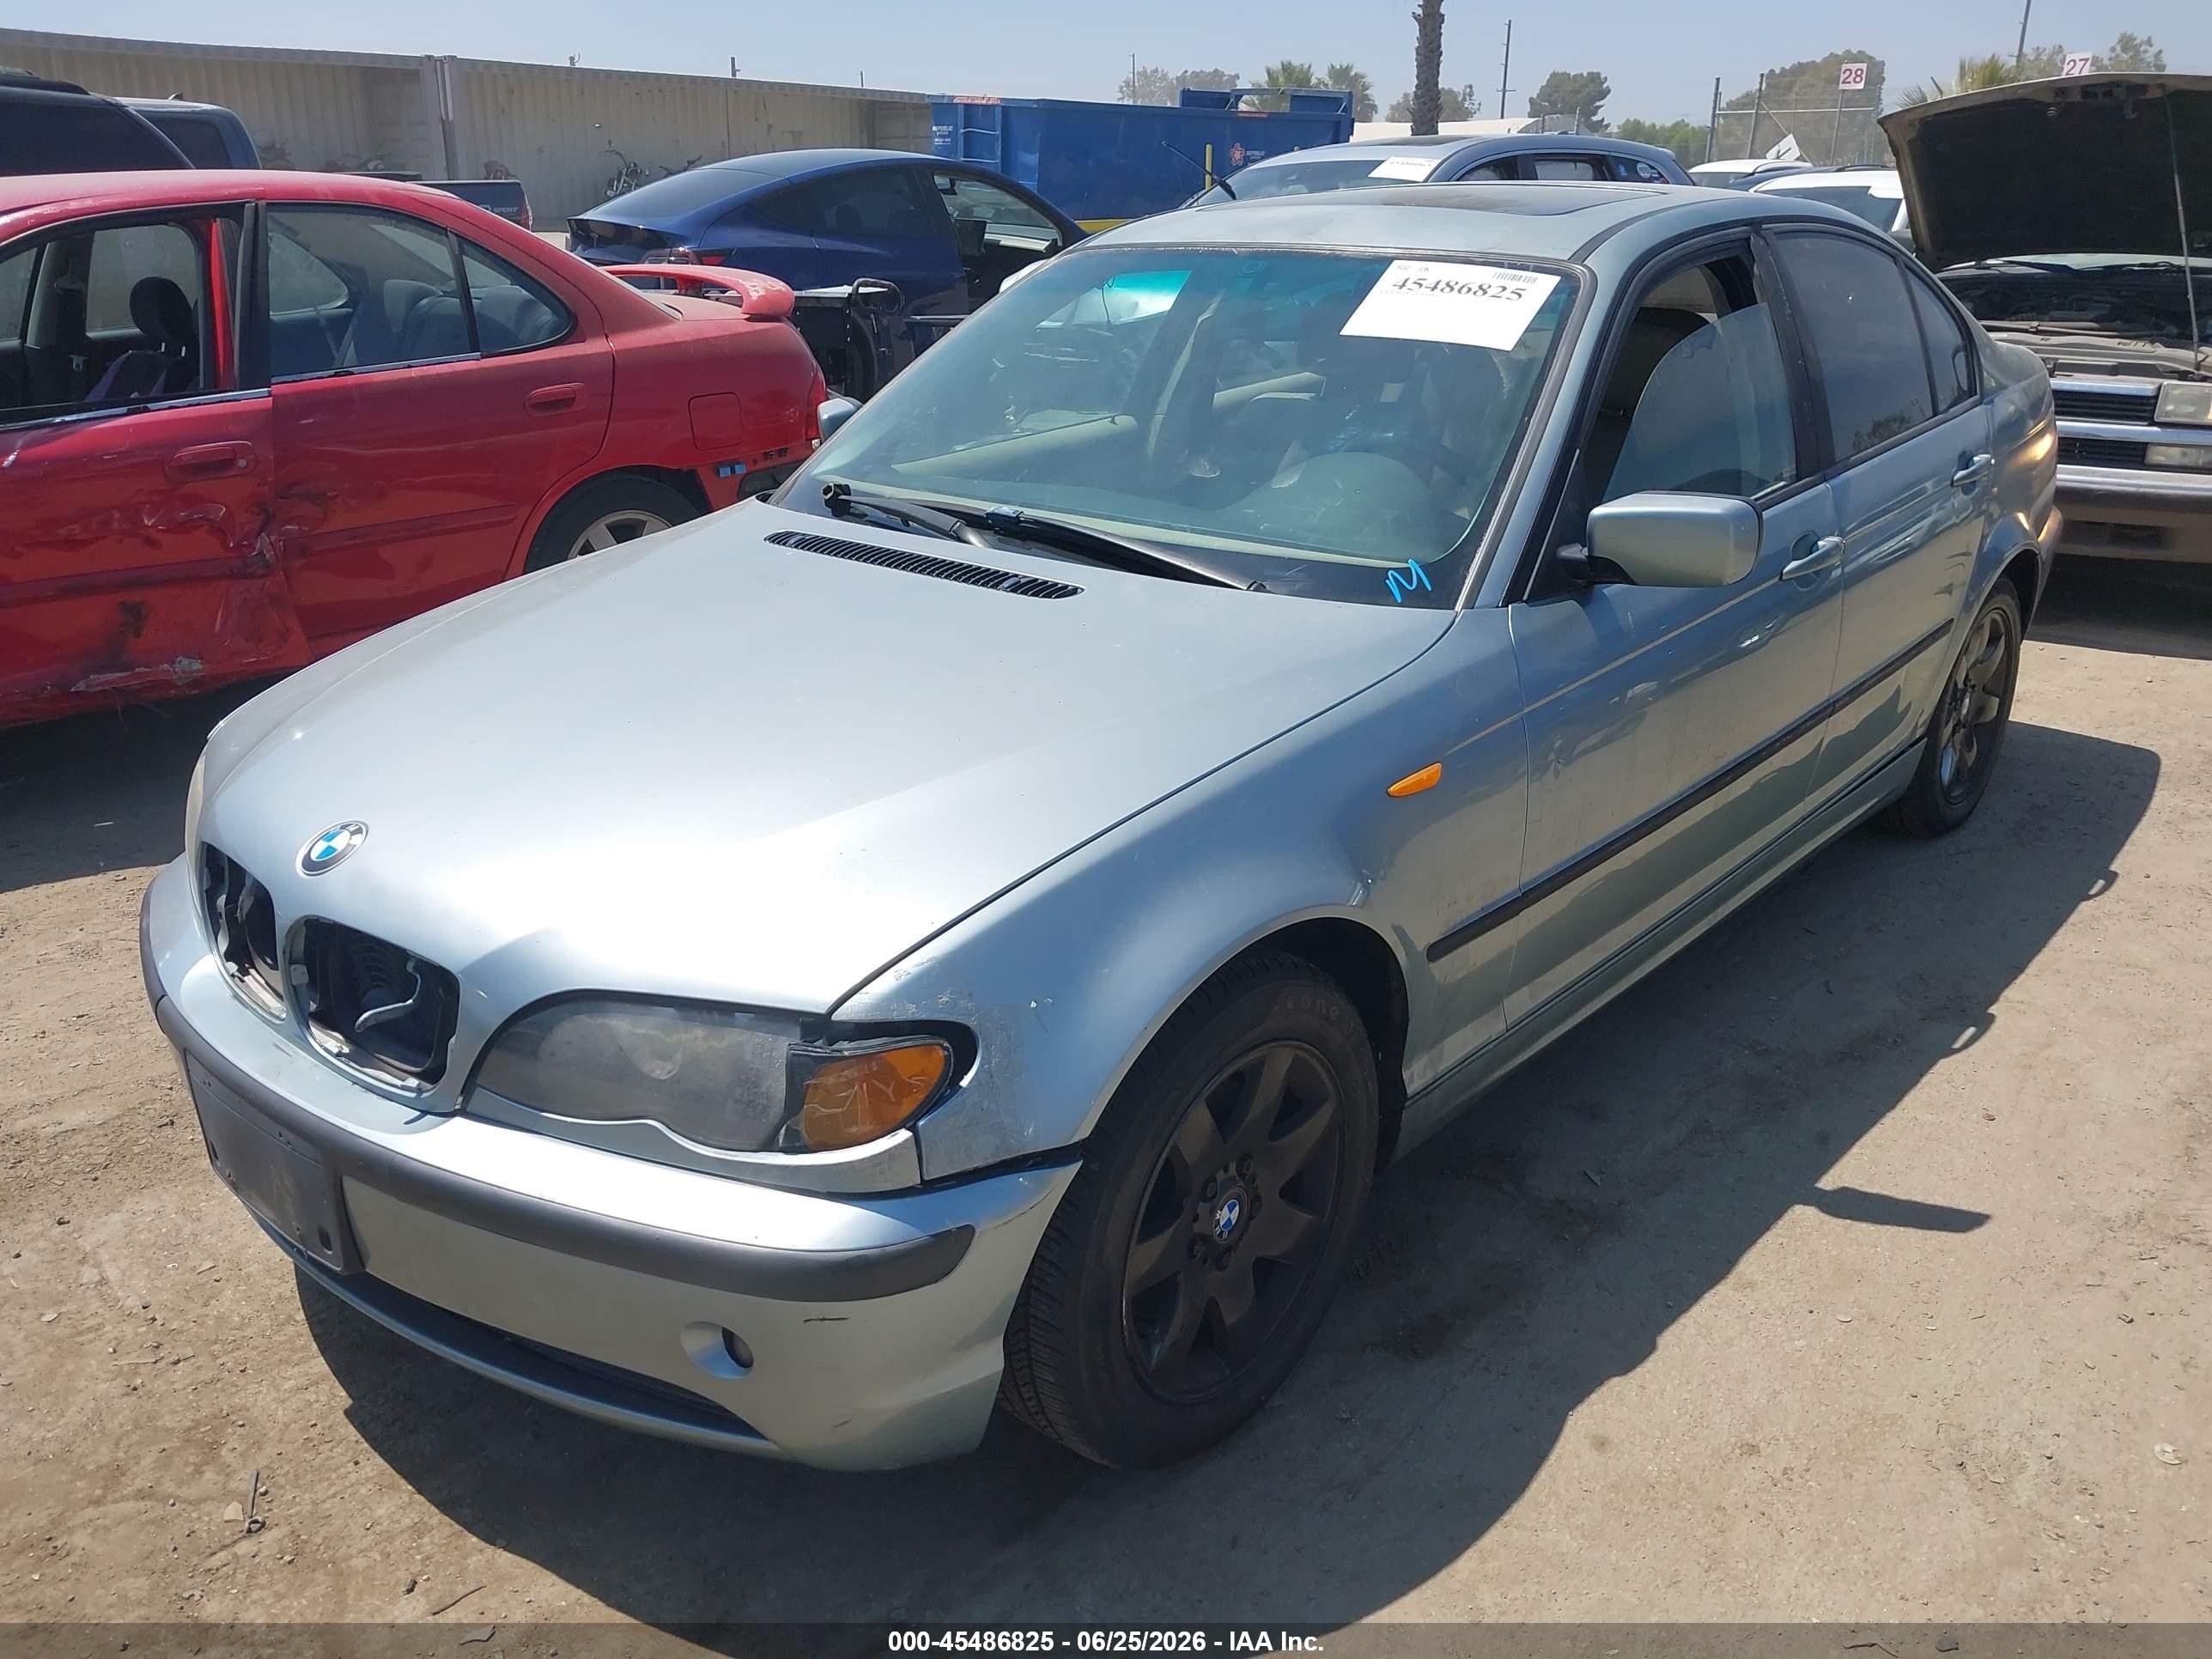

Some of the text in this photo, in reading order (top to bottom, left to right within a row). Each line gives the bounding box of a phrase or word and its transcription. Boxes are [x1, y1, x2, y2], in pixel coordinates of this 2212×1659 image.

[1840, 68, 1864, 84] 28
[2064, 57, 2090, 76] 27
[1392, 276, 1528, 301] 45486825
